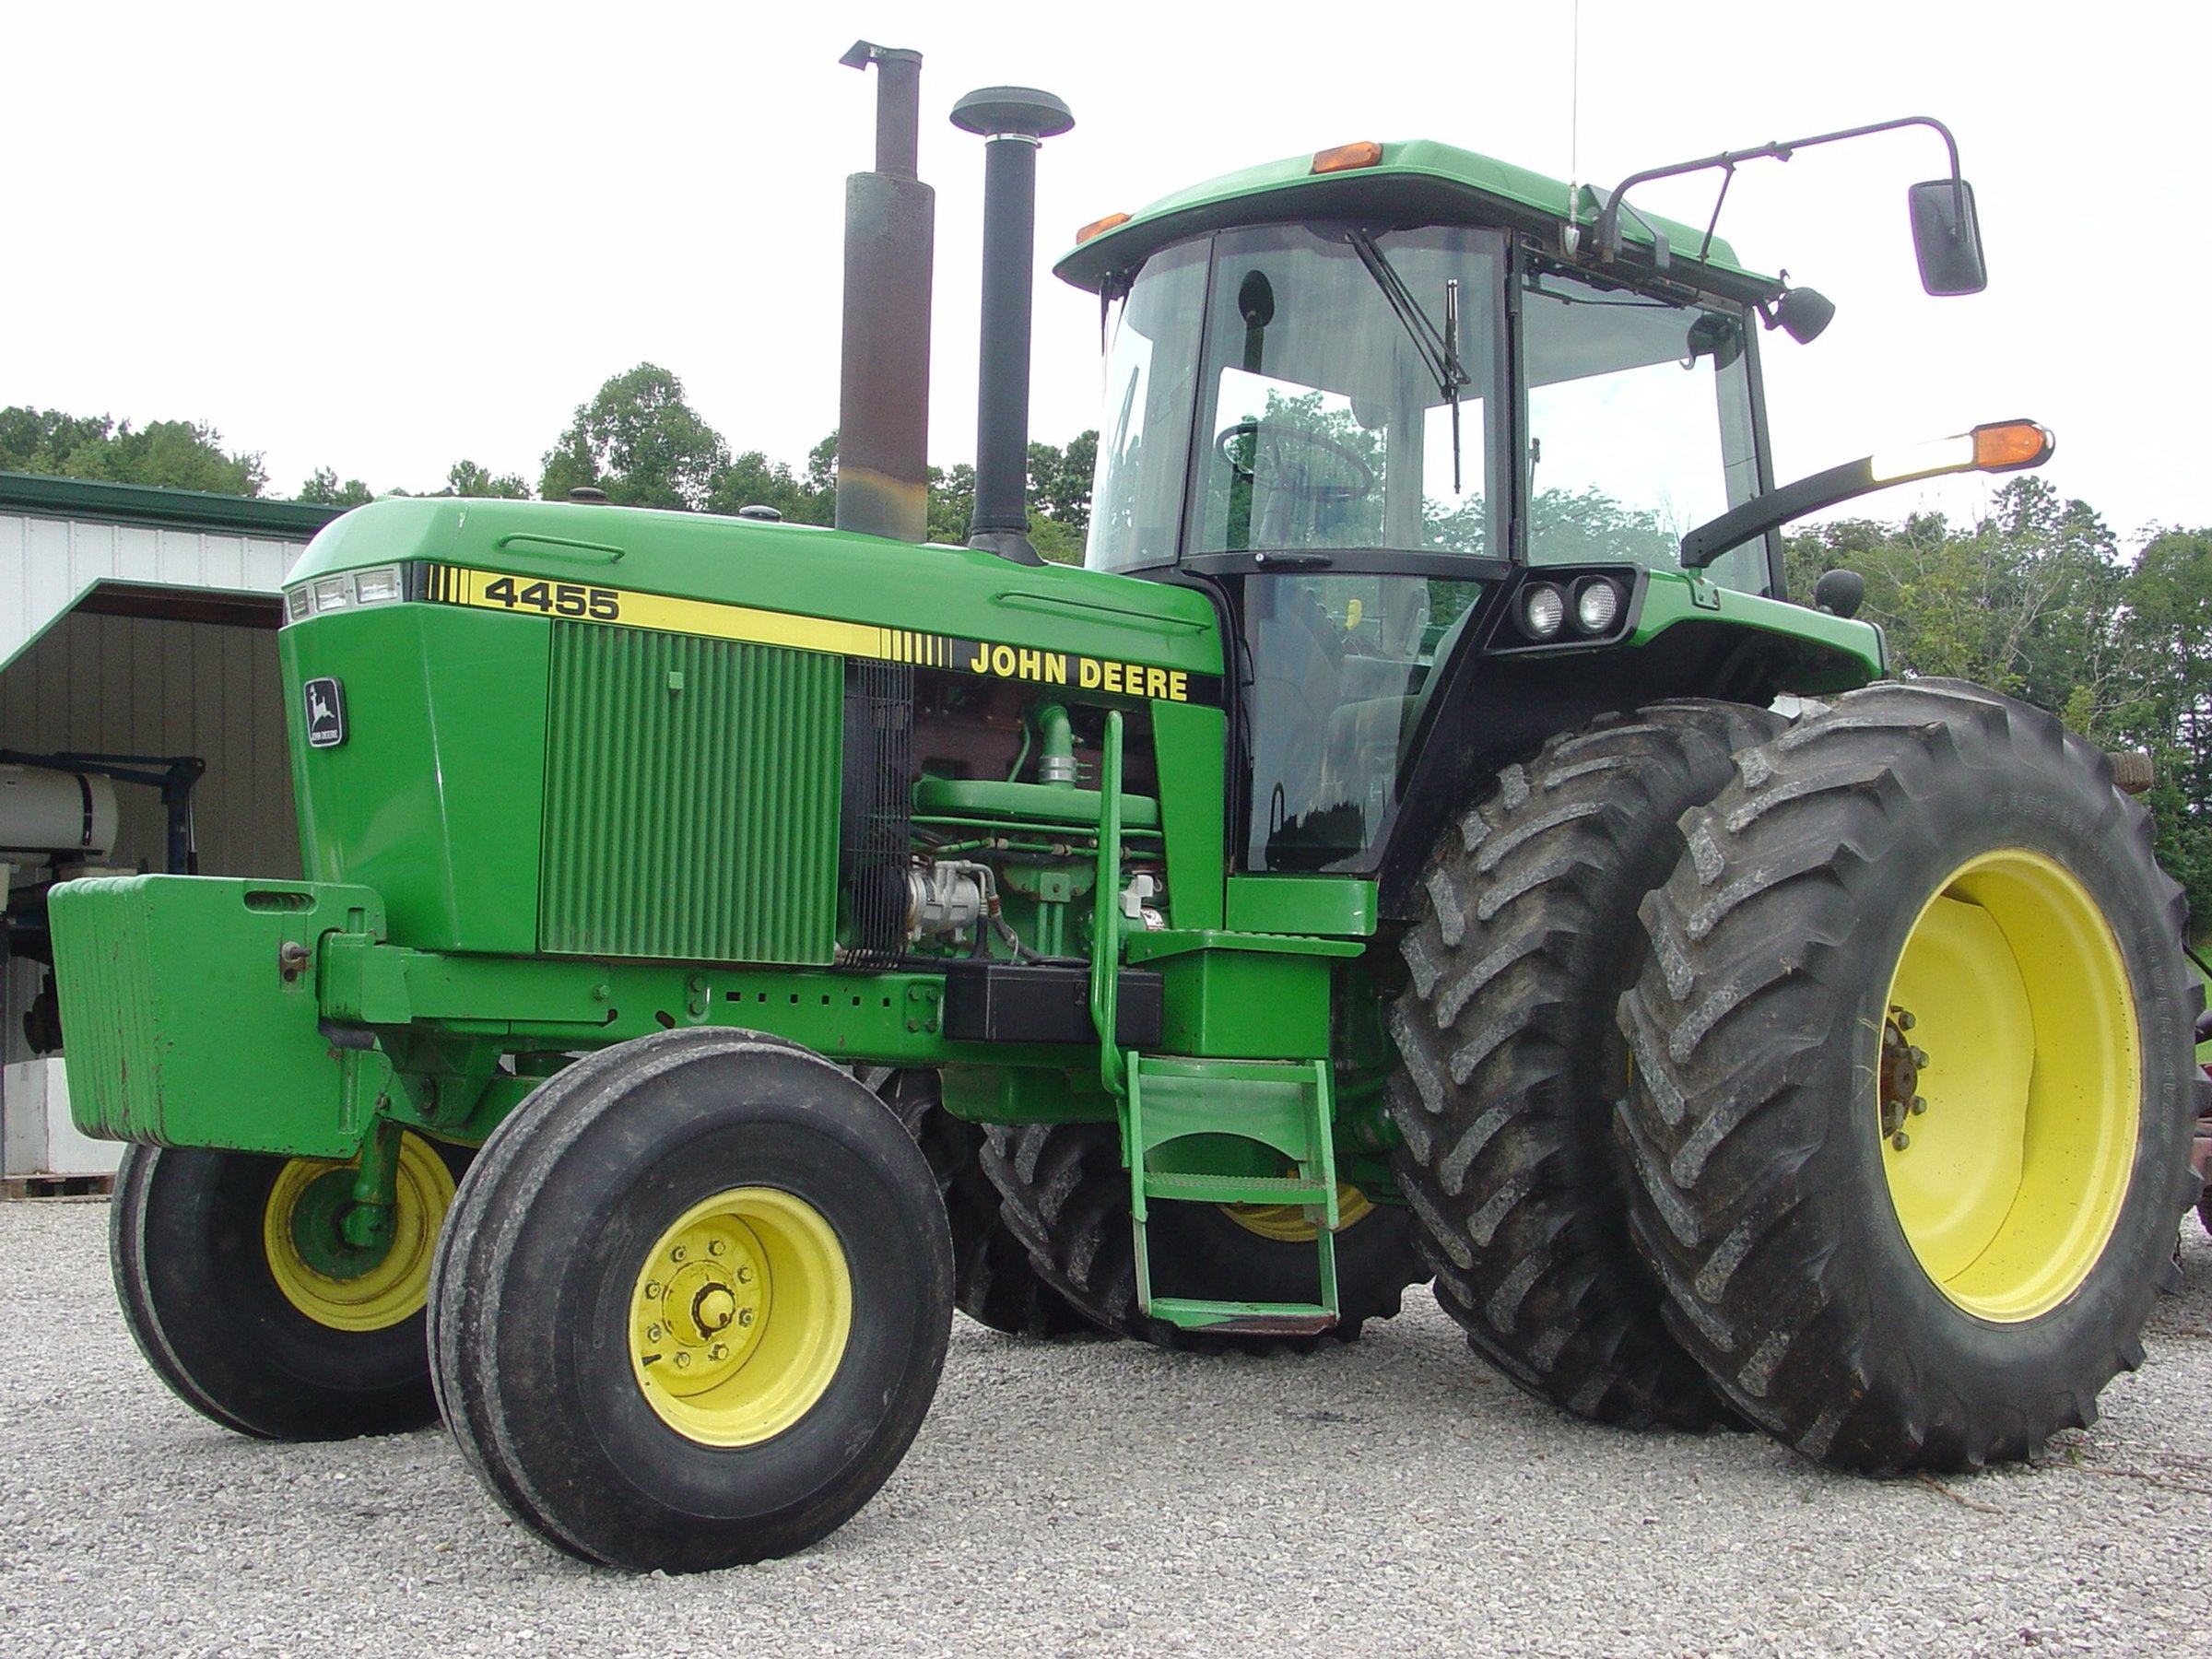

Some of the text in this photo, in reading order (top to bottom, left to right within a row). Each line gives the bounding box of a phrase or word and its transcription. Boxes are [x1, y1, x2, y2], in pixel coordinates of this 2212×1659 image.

[485, 577, 619, 620] 4455
[971, 642, 1187, 701] JOHN DEERE
